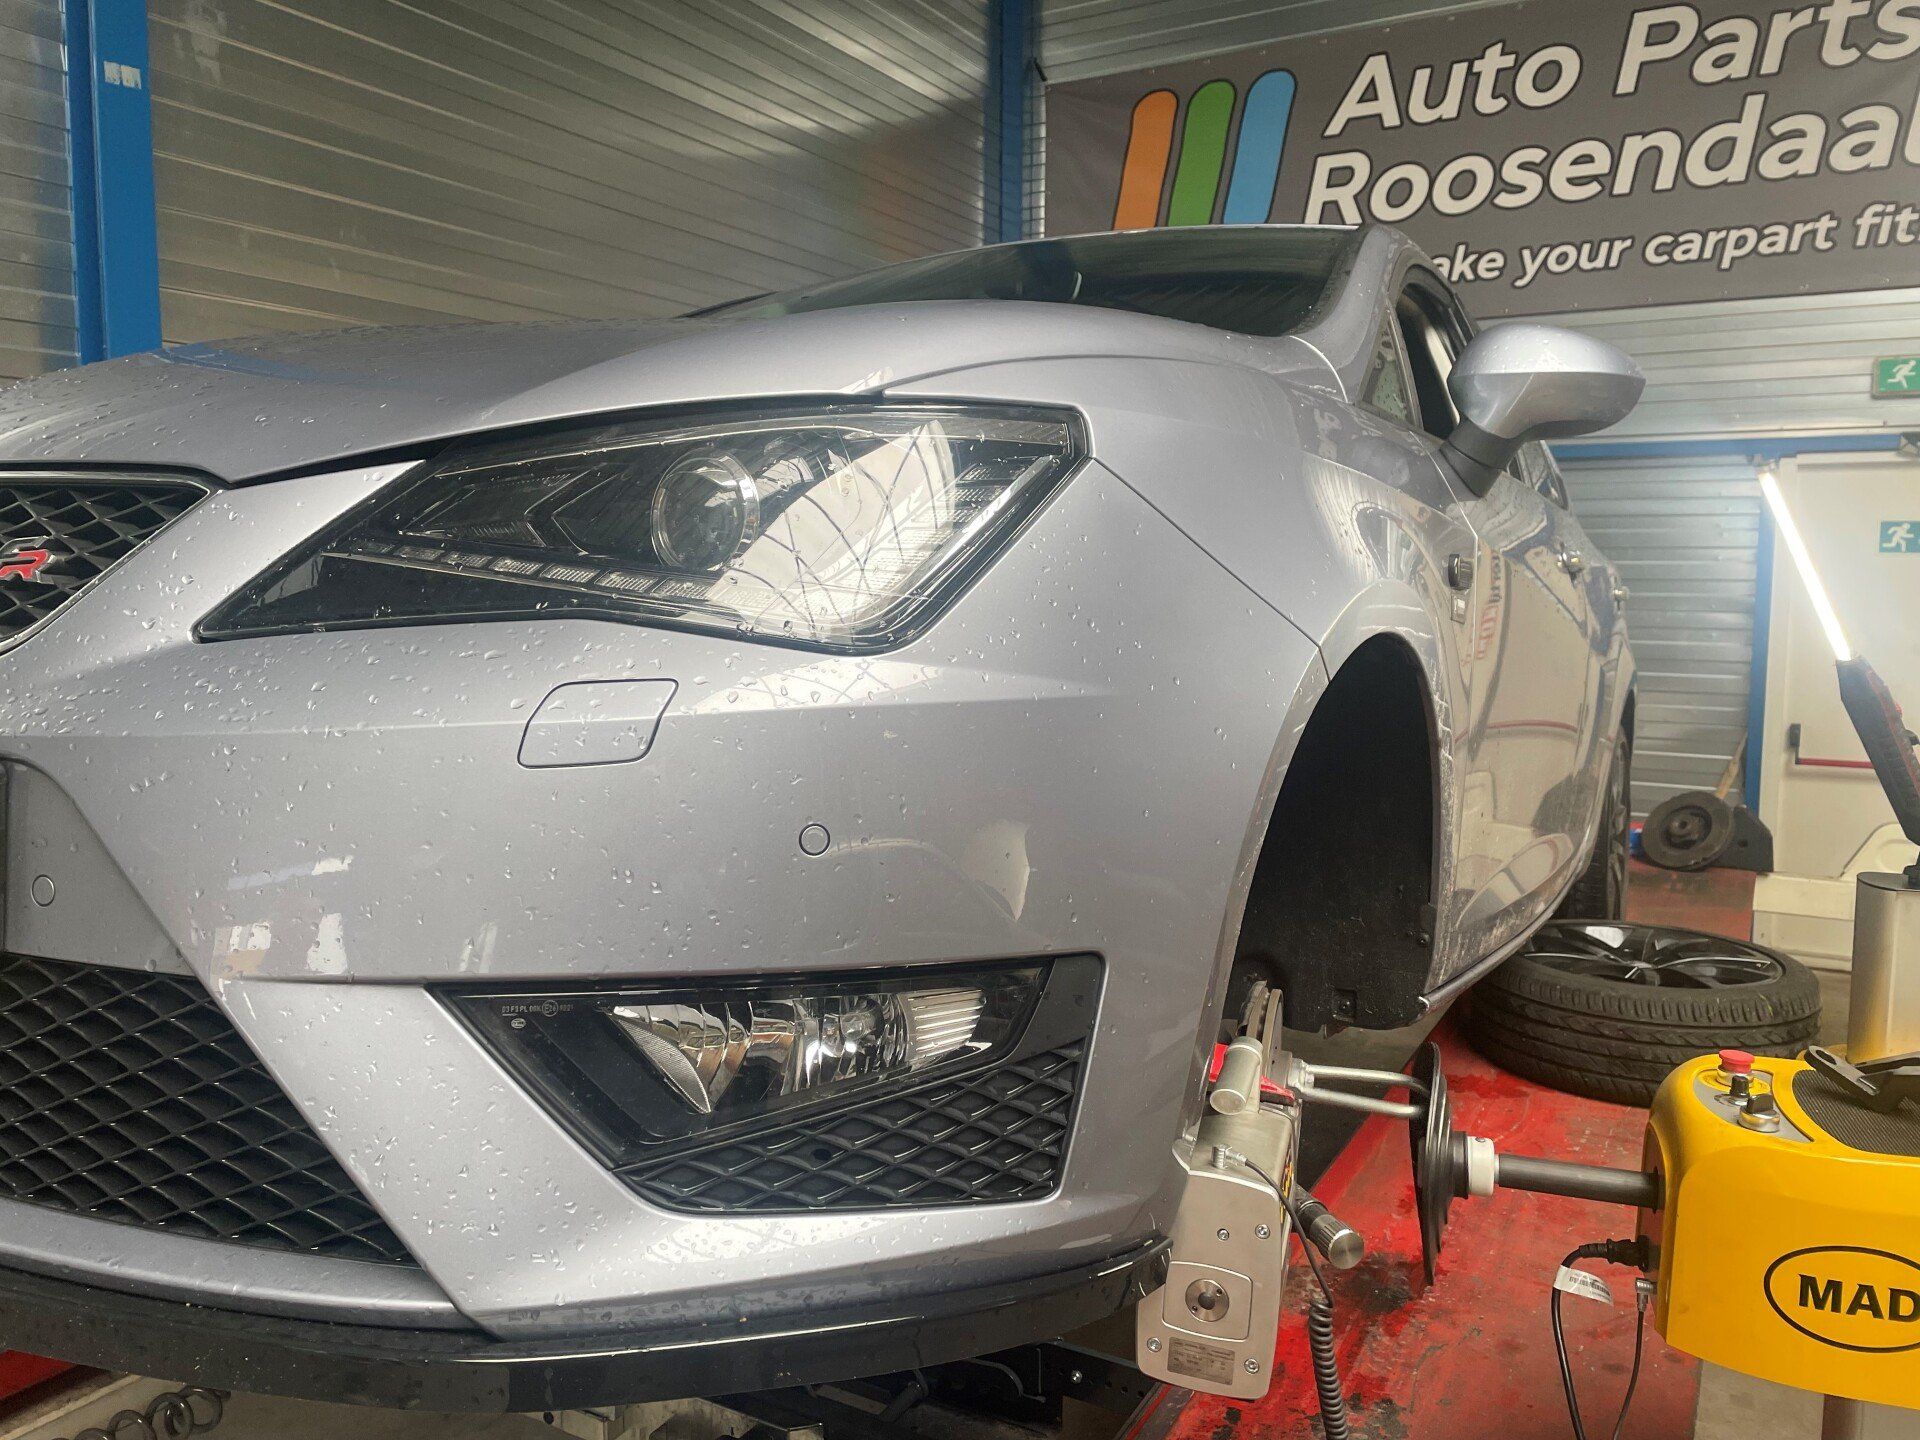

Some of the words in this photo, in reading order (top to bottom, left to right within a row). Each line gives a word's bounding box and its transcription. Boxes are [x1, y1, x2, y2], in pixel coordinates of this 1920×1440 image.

[1322, 42, 1582, 138] Auto
[1613, 0, 1920, 95] Parts
[1432, 243, 1504, 283] ake
[1513, 237, 1633, 288] your
[1645, 213, 1838, 270] carpart
[1855, 203, 1920, 248] fit
[1798, 1273, 1920, 1323] MAD
